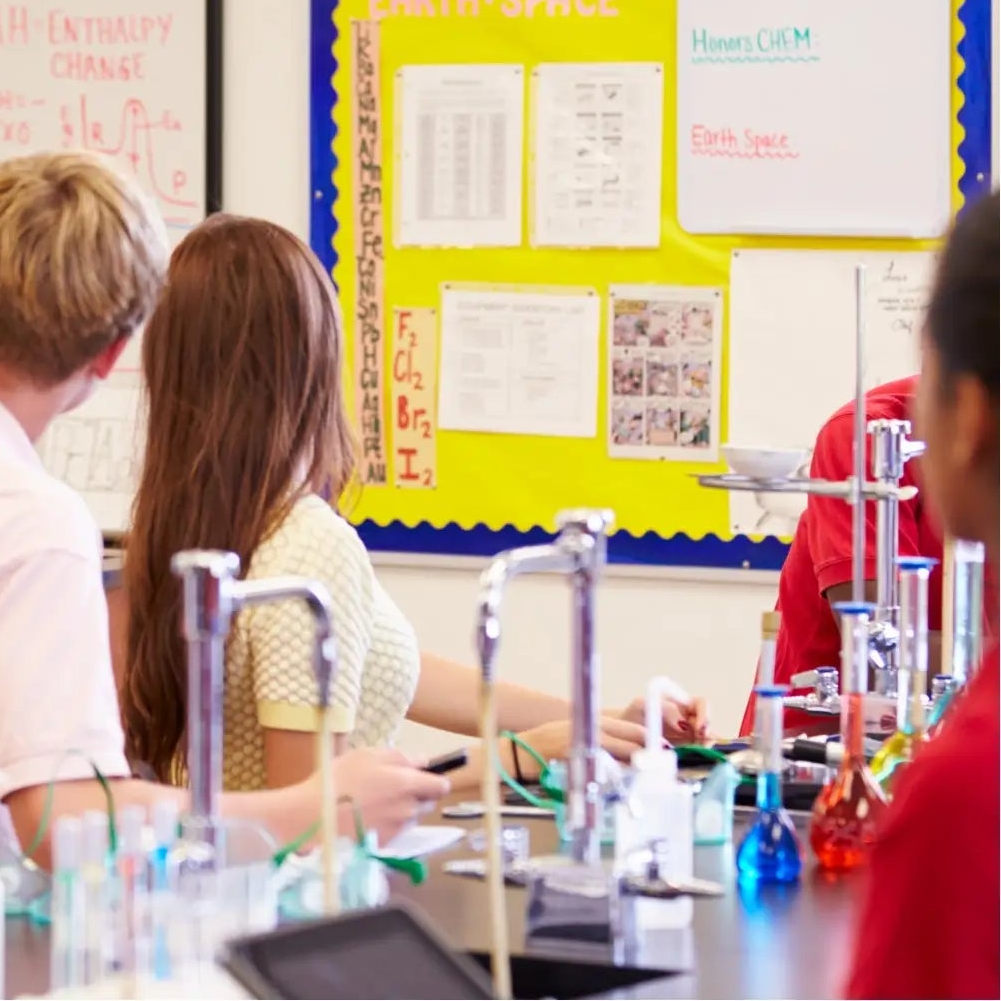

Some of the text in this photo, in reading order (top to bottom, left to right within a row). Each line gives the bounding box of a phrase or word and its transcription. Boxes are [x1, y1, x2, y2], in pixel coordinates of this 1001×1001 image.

[46, 7, 175, 47] ENTHALPY
[49, 50, 146, 82] CHANGE
[691, 124, 738, 149] Earth
